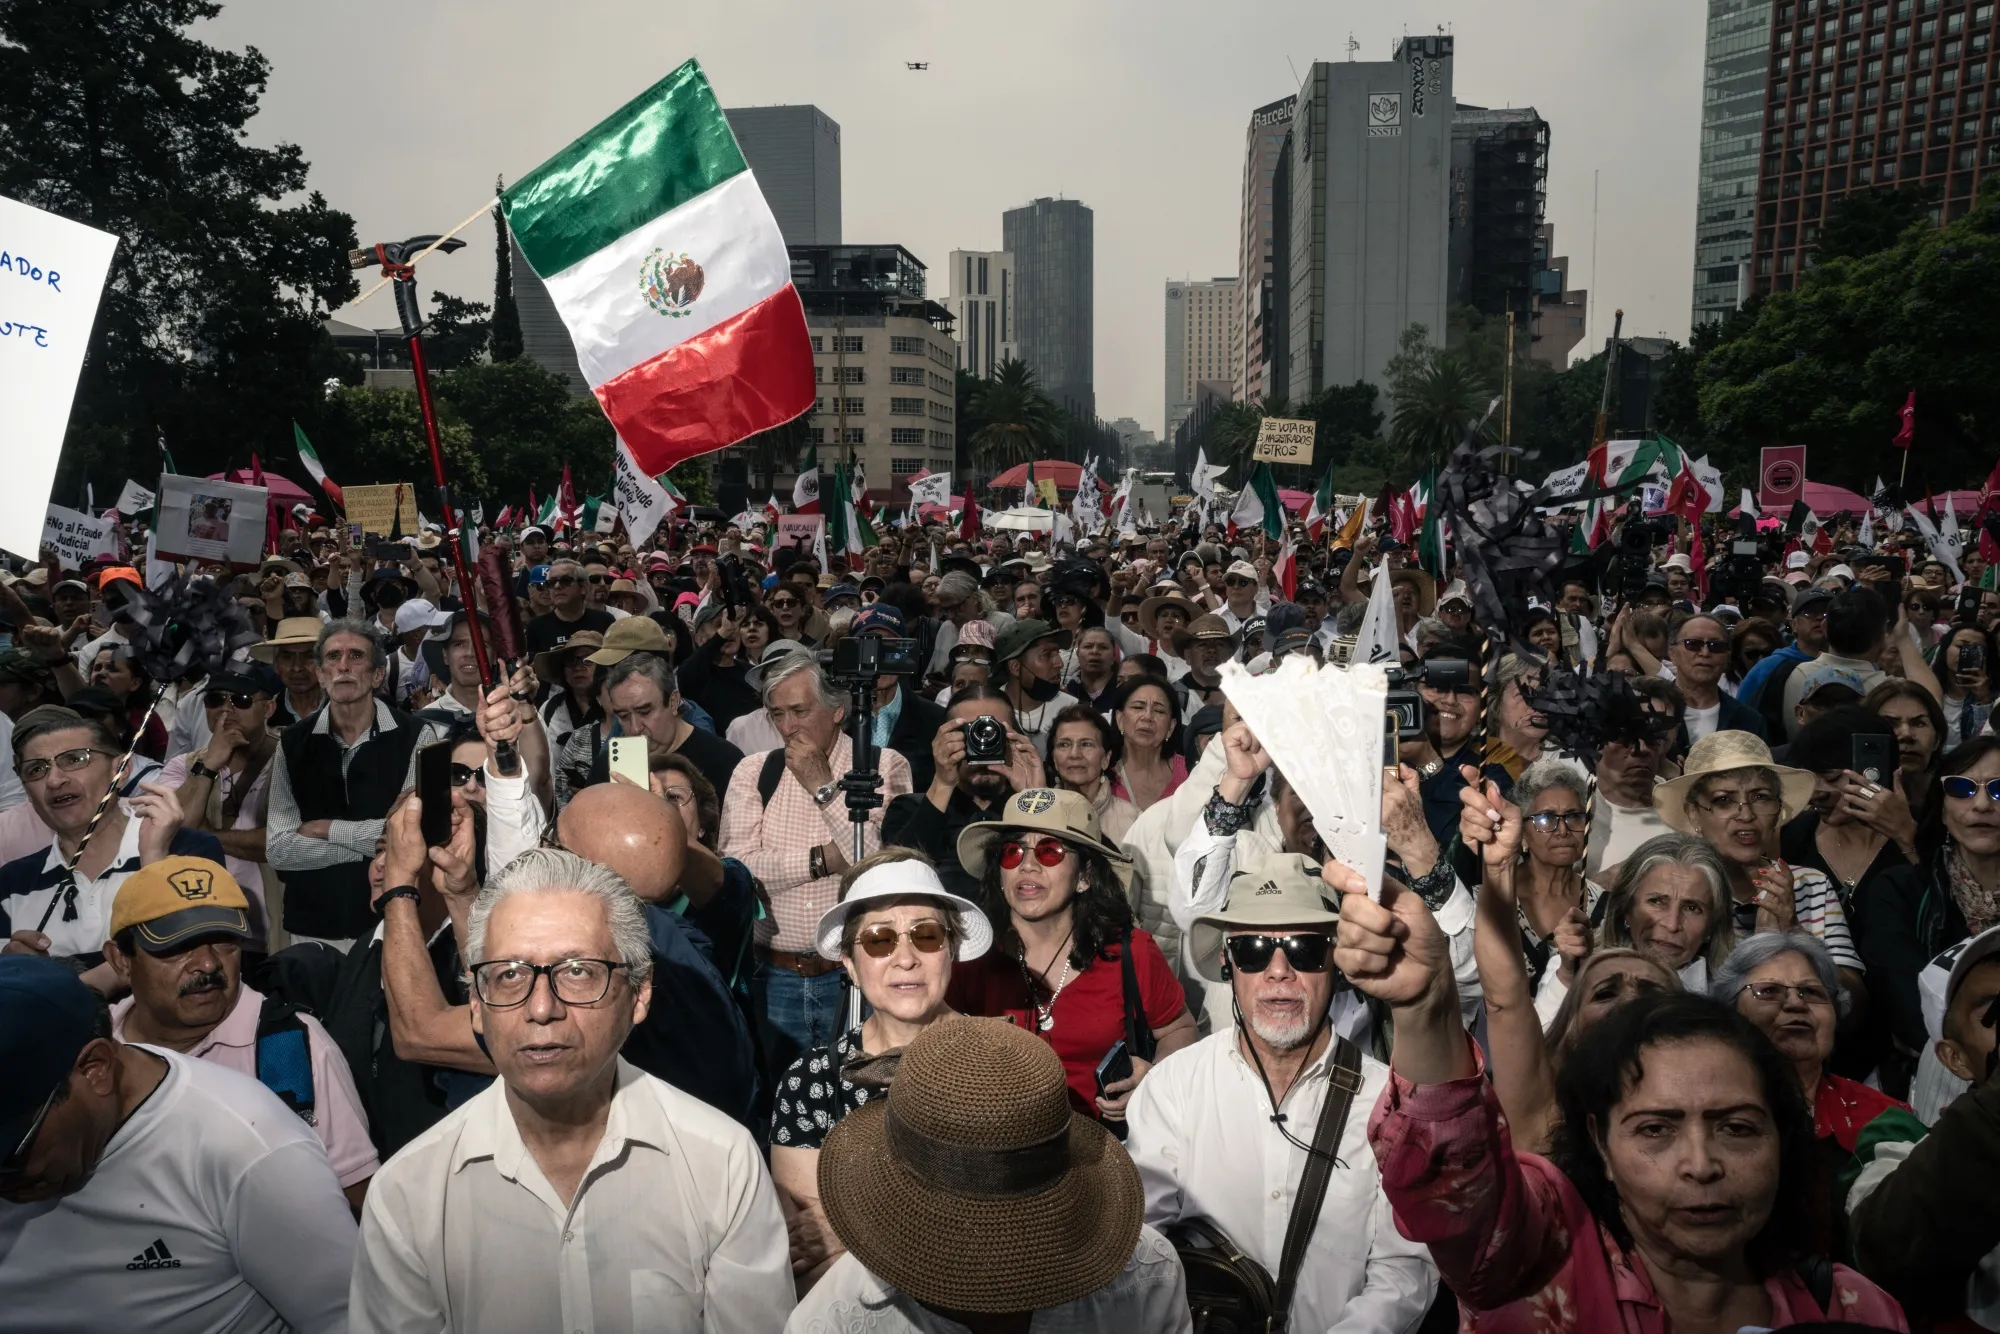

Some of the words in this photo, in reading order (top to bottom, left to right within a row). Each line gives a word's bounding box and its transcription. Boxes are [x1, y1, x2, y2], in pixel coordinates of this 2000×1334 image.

[1254, 98, 1294, 129] Barceló
[0, 251, 60, 292] ADOR
[1265, 422, 1276, 430] SE
[1279, 423, 1298, 433] VOTA
[1299, 424, 1314, 435] POR
[66, 522, 75, 532] al
[76, 524, 102, 540] Fraude
[56, 533, 90, 550] Judicial
[61, 549, 72, 559] no
[126, 1258, 182, 1270] adidas
